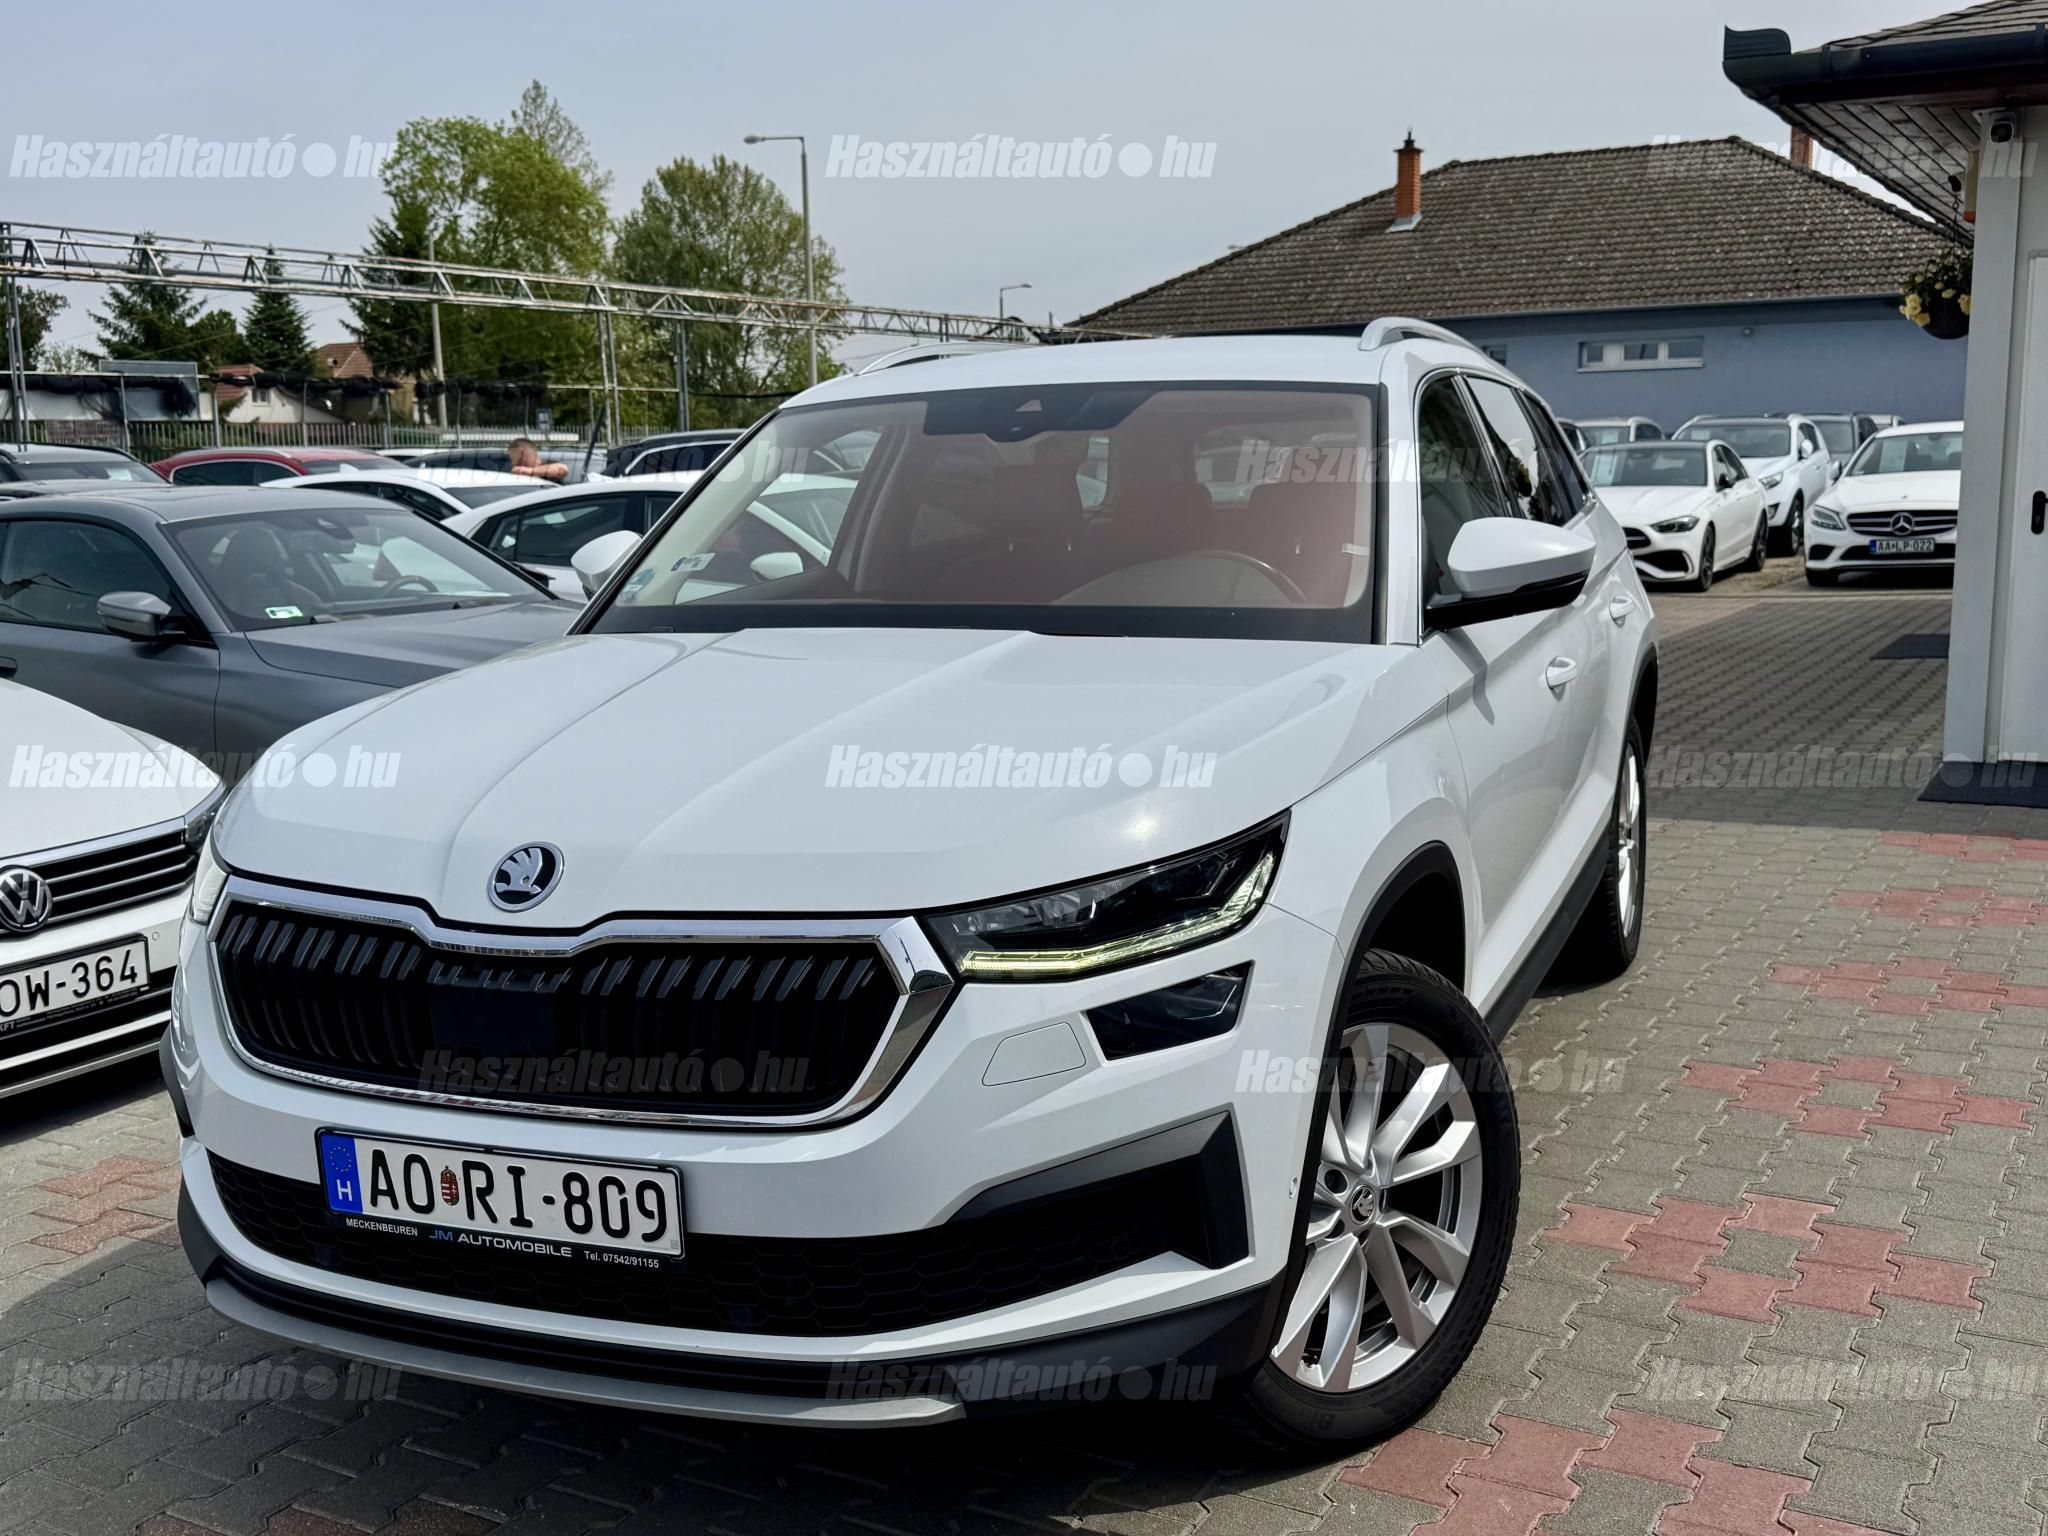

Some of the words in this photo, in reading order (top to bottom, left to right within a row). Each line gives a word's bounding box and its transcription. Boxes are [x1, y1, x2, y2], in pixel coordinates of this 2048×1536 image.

[1877, 540, 1892, 552] AA
[1895, 539, 1933, 553] LP-022
[0, 948, 138, 1018] OW-364
[335, 1179, 353, 1202] H
[370, 1149, 436, 1215] AO
[462, 1159, 668, 1243] RI-809
[345, 1218, 418, 1237] MECKENBEUREN
[428, 1229, 454, 1242] JM
[457, 1232, 573, 1258] AUTOMOBILE
[584, 1250, 601, 1262] Tel.
[602, 1252, 660, 1269] 07542/91155
